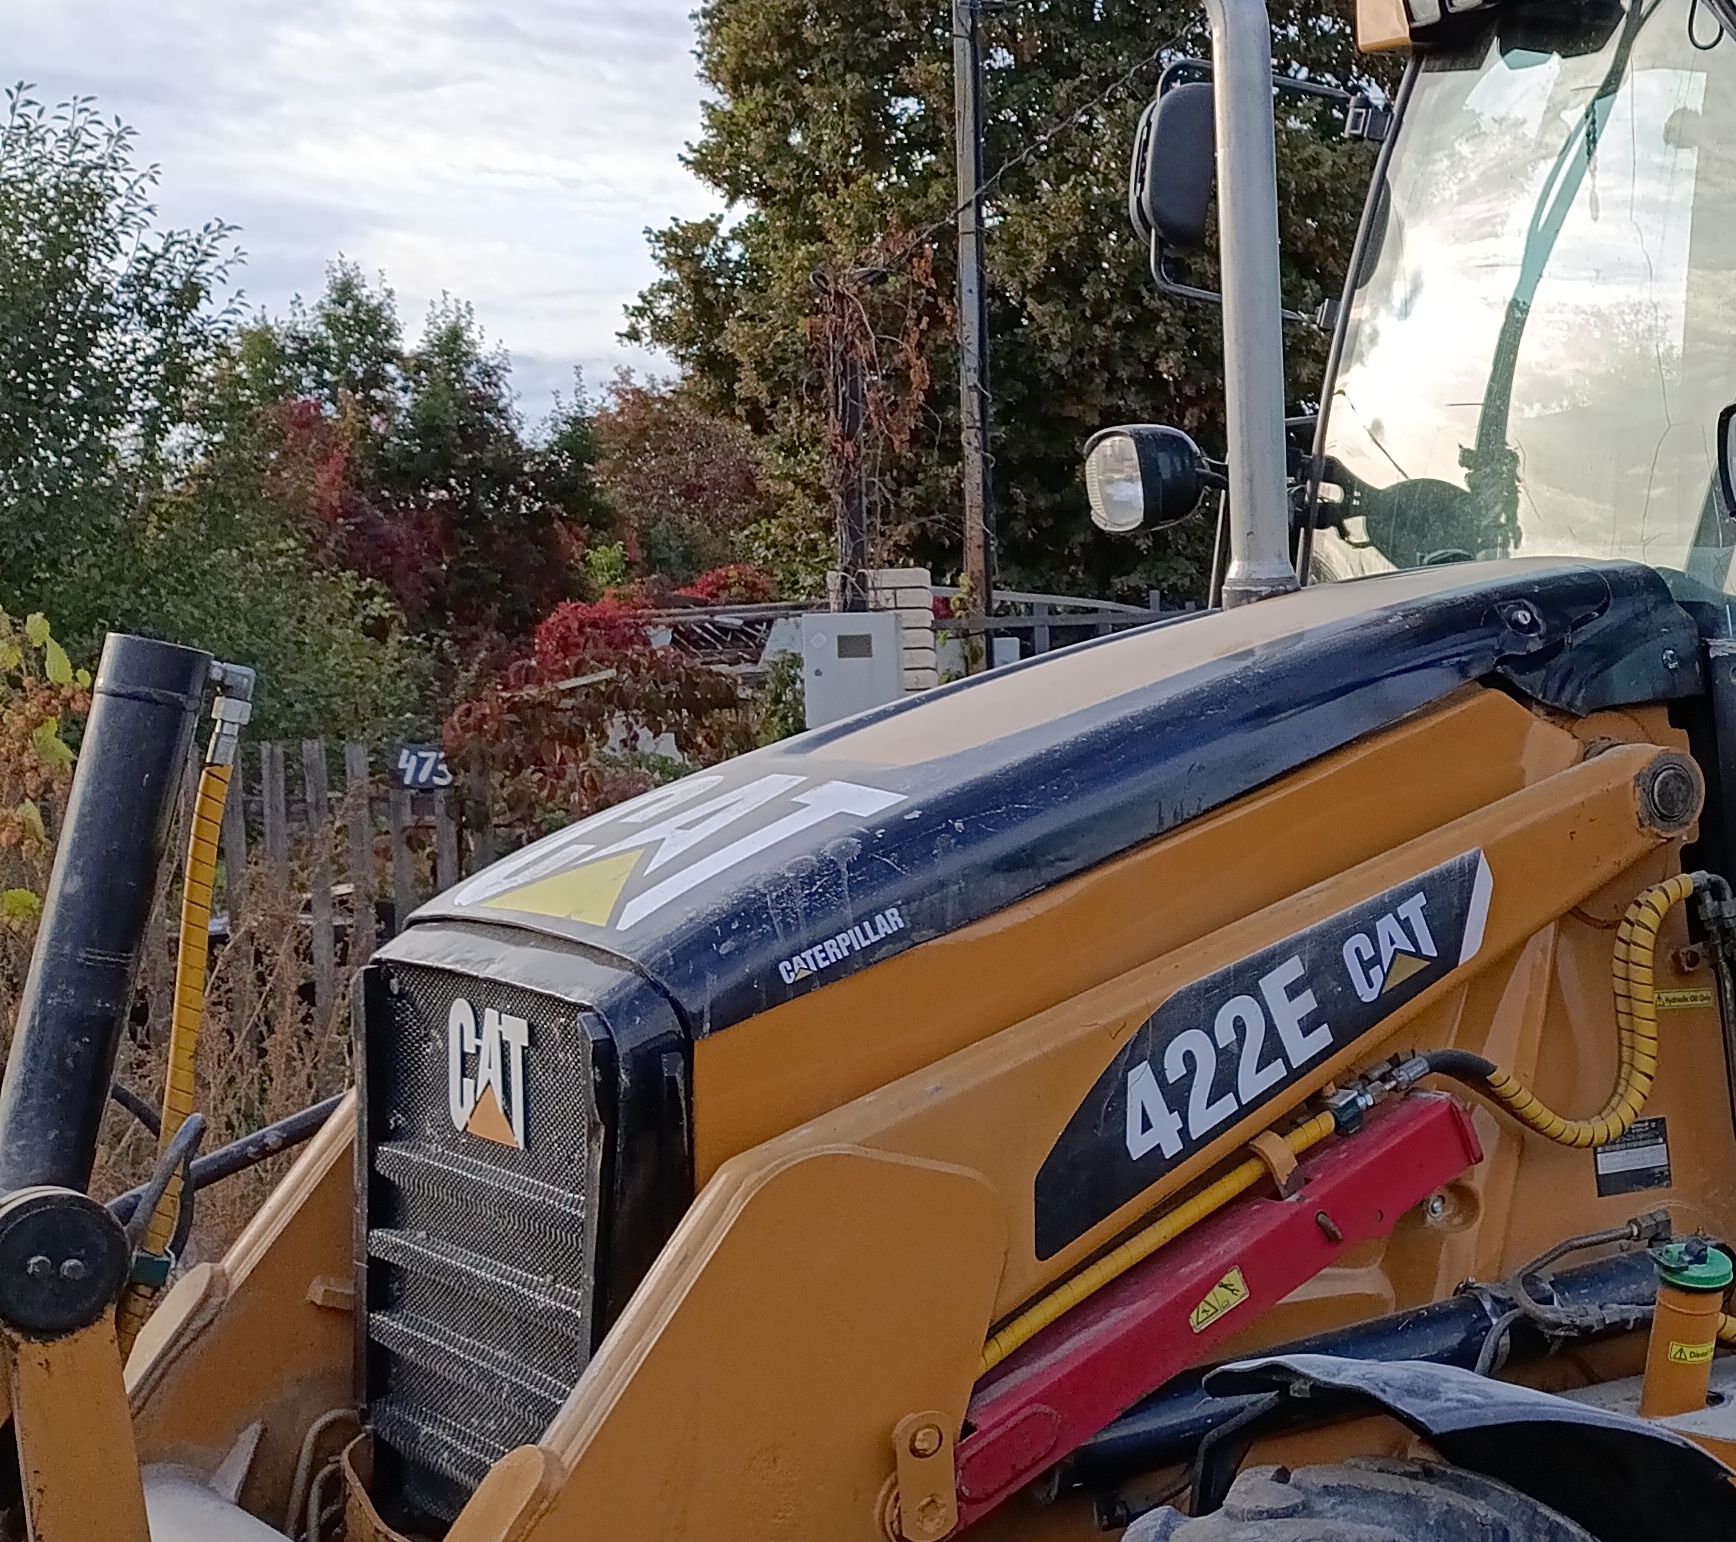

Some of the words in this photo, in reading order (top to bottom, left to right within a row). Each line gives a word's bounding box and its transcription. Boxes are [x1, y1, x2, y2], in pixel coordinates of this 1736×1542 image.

[453, 773, 909, 931] CAT
[779, 907, 905, 984] CATERPILLAR
[447, 998, 530, 1151] CAT
[1126, 955, 1334, 1161] 422E
[1342, 891, 1438, 1003] CAT
